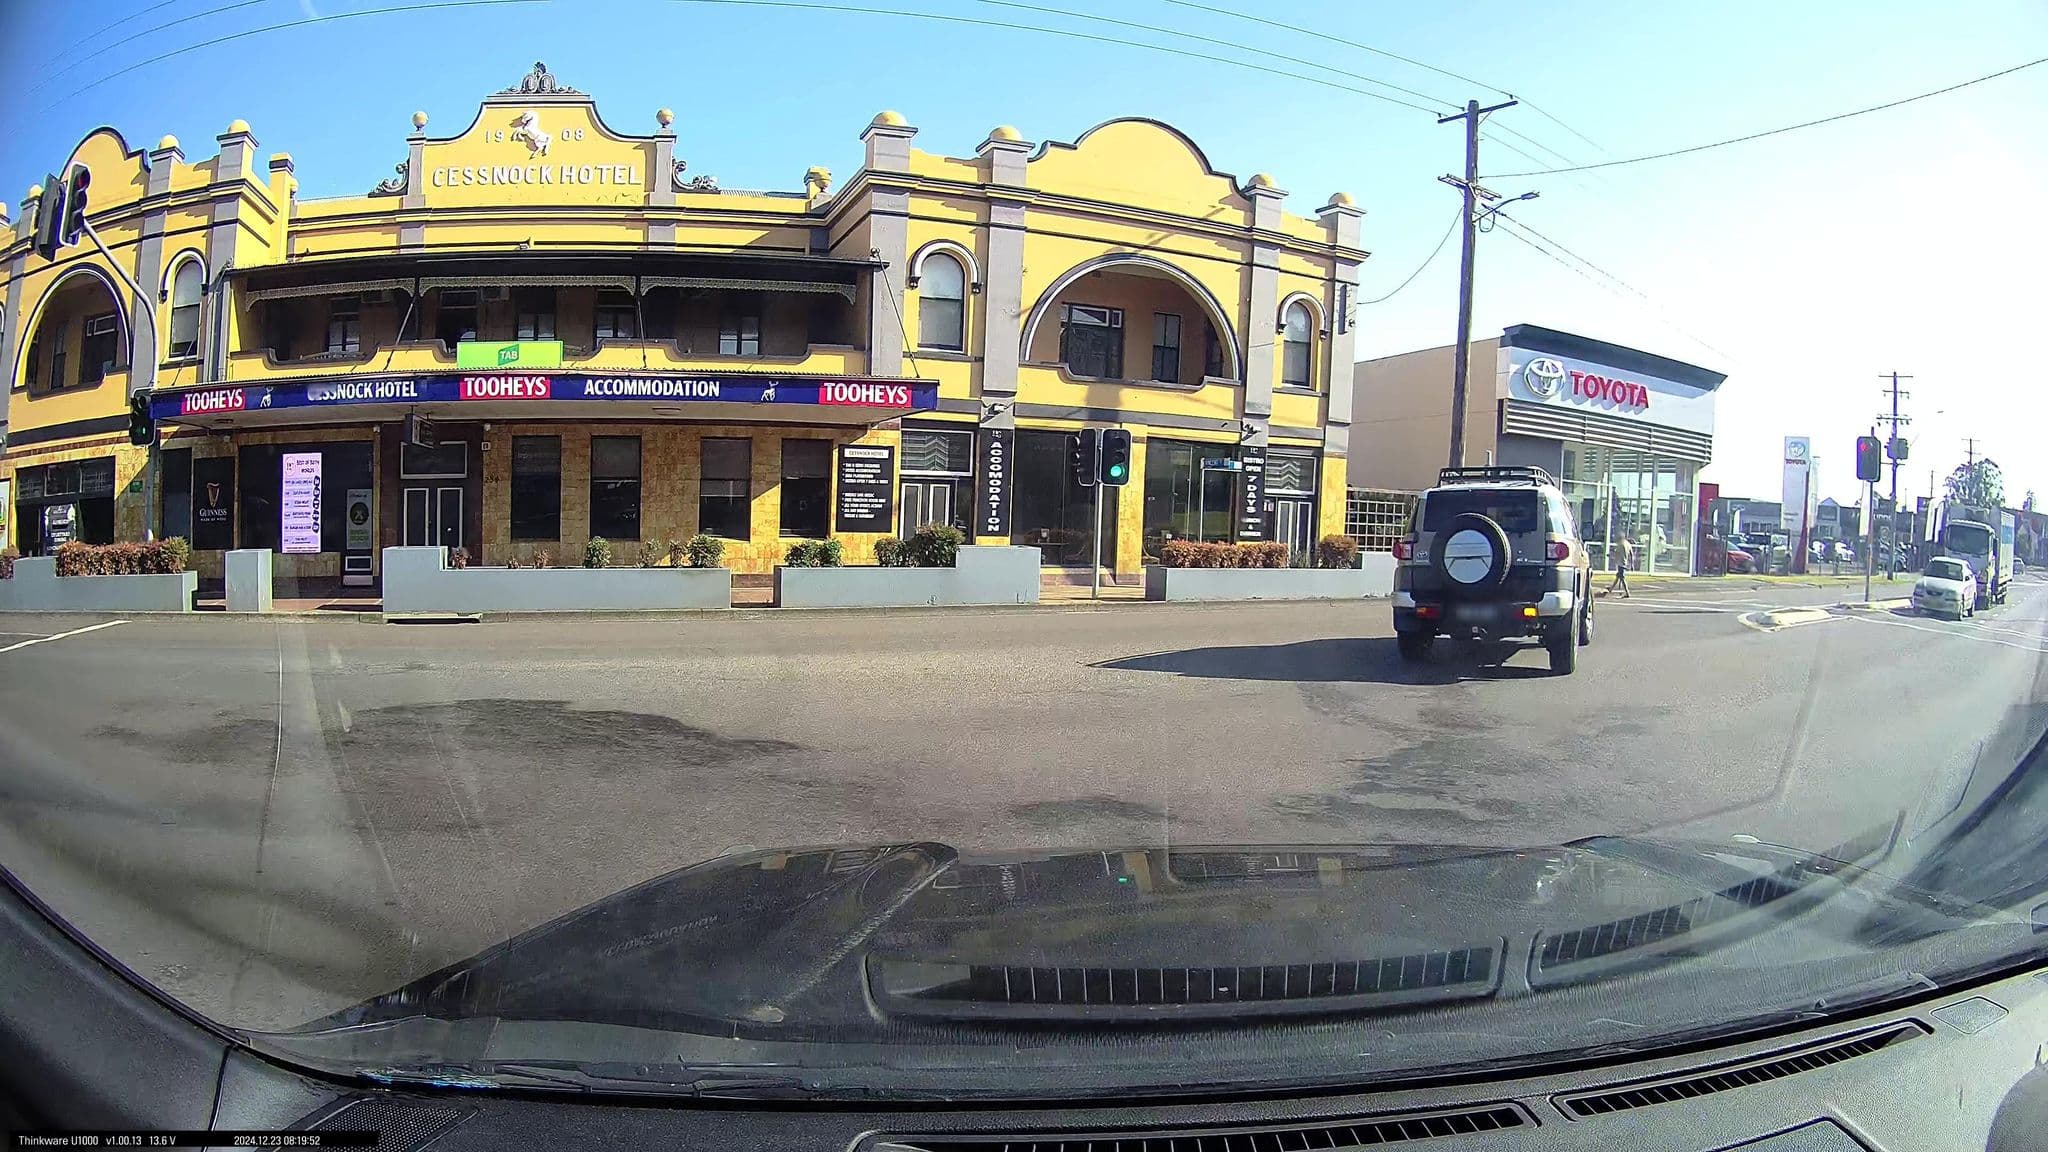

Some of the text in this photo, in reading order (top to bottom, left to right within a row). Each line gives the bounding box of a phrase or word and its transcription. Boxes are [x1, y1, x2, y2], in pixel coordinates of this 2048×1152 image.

[485, 128, 585, 143] 19 08
[432, 165, 642, 187] CESSNOCK HOTEL
[500, 350, 518, 360] TAB
[376, 381, 417, 397] HOTEL
[465, 376, 546, 397] TOOHEYS
[584, 379, 720, 398] ACCOMMODATION
[824, 382, 907, 404] TOOHEYS
[1570, 370, 1649, 408] TOYOTA
[185, 389, 243, 411] TOOHEYS
[1246, 485, 1257, 513] DAYS
[199, 508, 228, 517] GUINNESS
